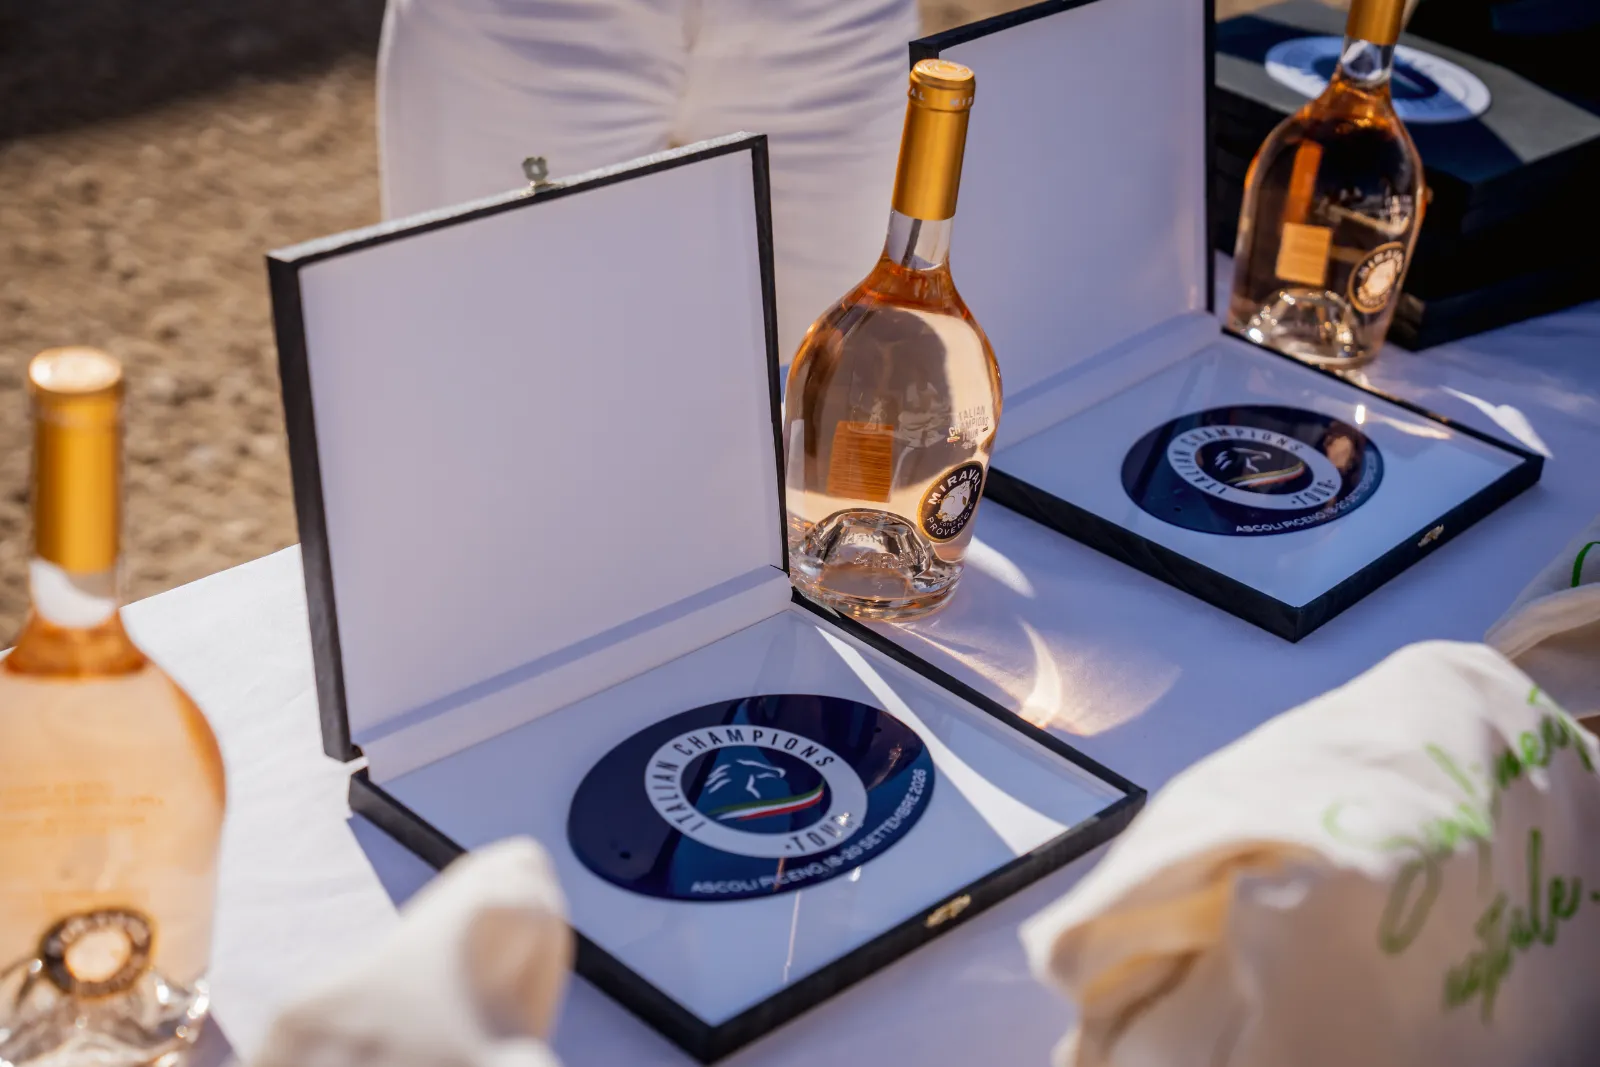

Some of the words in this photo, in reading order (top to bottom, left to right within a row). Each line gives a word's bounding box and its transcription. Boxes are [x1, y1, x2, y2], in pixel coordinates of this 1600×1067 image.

[957, 405, 986, 422] TALIAN
[1181, 428, 1303, 452] CHAMPIONS
[928, 469, 981, 505] MIRAVAL
[1172, 449, 1227, 494] ITALIAN
[926, 501, 975, 536] PROVENCE
[1235, 522, 1283, 534] ASCOLI
[672, 728, 836, 768] CHAMPIONS
[653, 758, 707, 833] ITALIAN
[690, 878, 758, 894] ASCOLI
